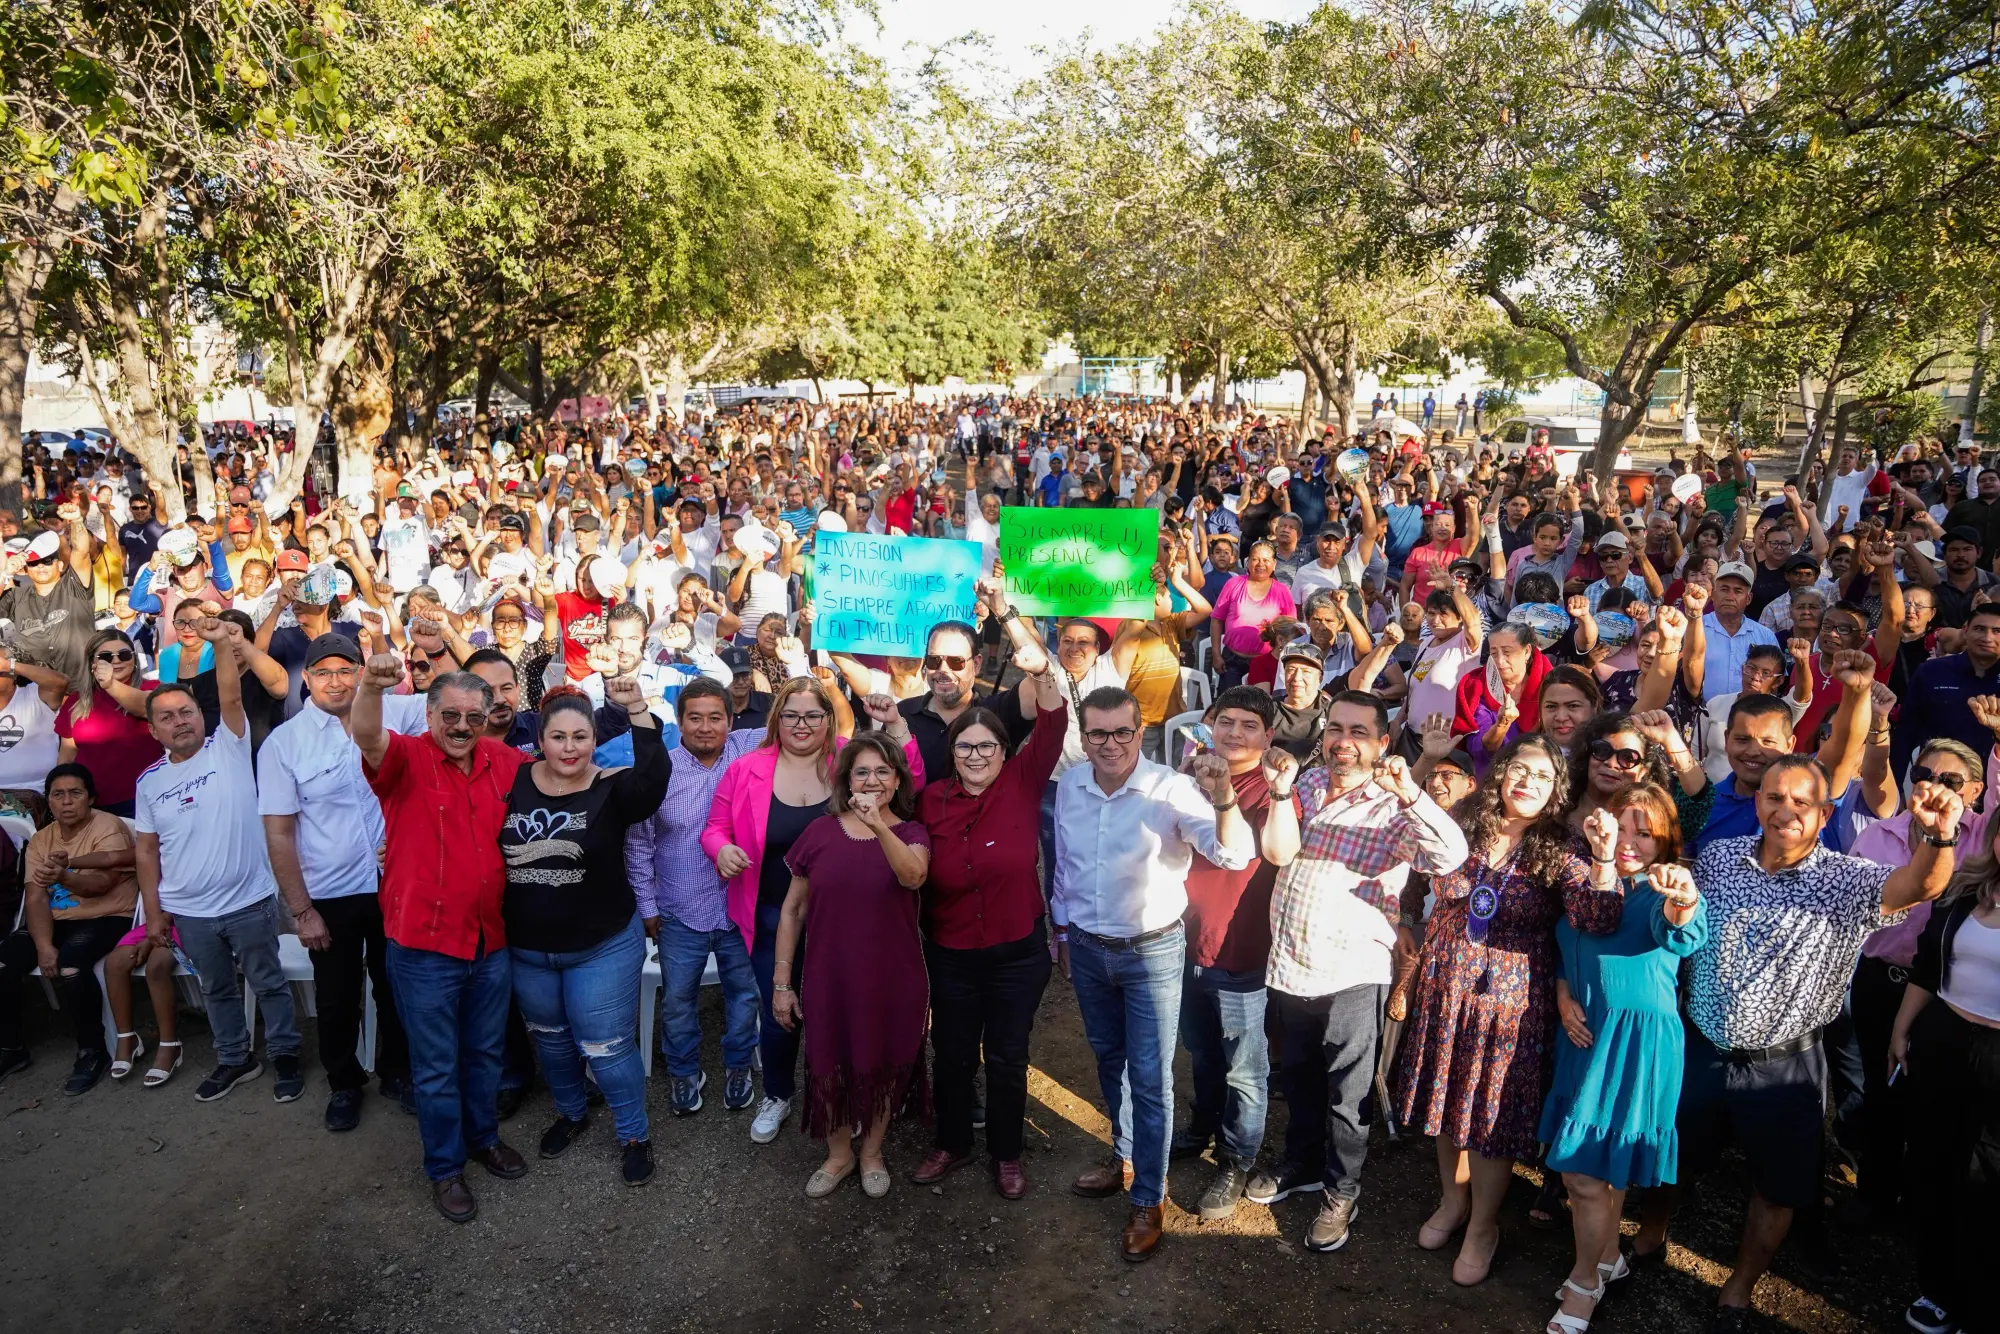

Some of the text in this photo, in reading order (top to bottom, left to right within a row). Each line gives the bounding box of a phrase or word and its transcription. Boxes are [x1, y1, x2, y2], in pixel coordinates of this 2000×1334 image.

[821, 538, 902, 562] INVASION
[840, 564, 946, 593] PINOSUARES
[823, 590, 894, 616] SIEMPRE
[854, 619, 915, 646] IMELDA
